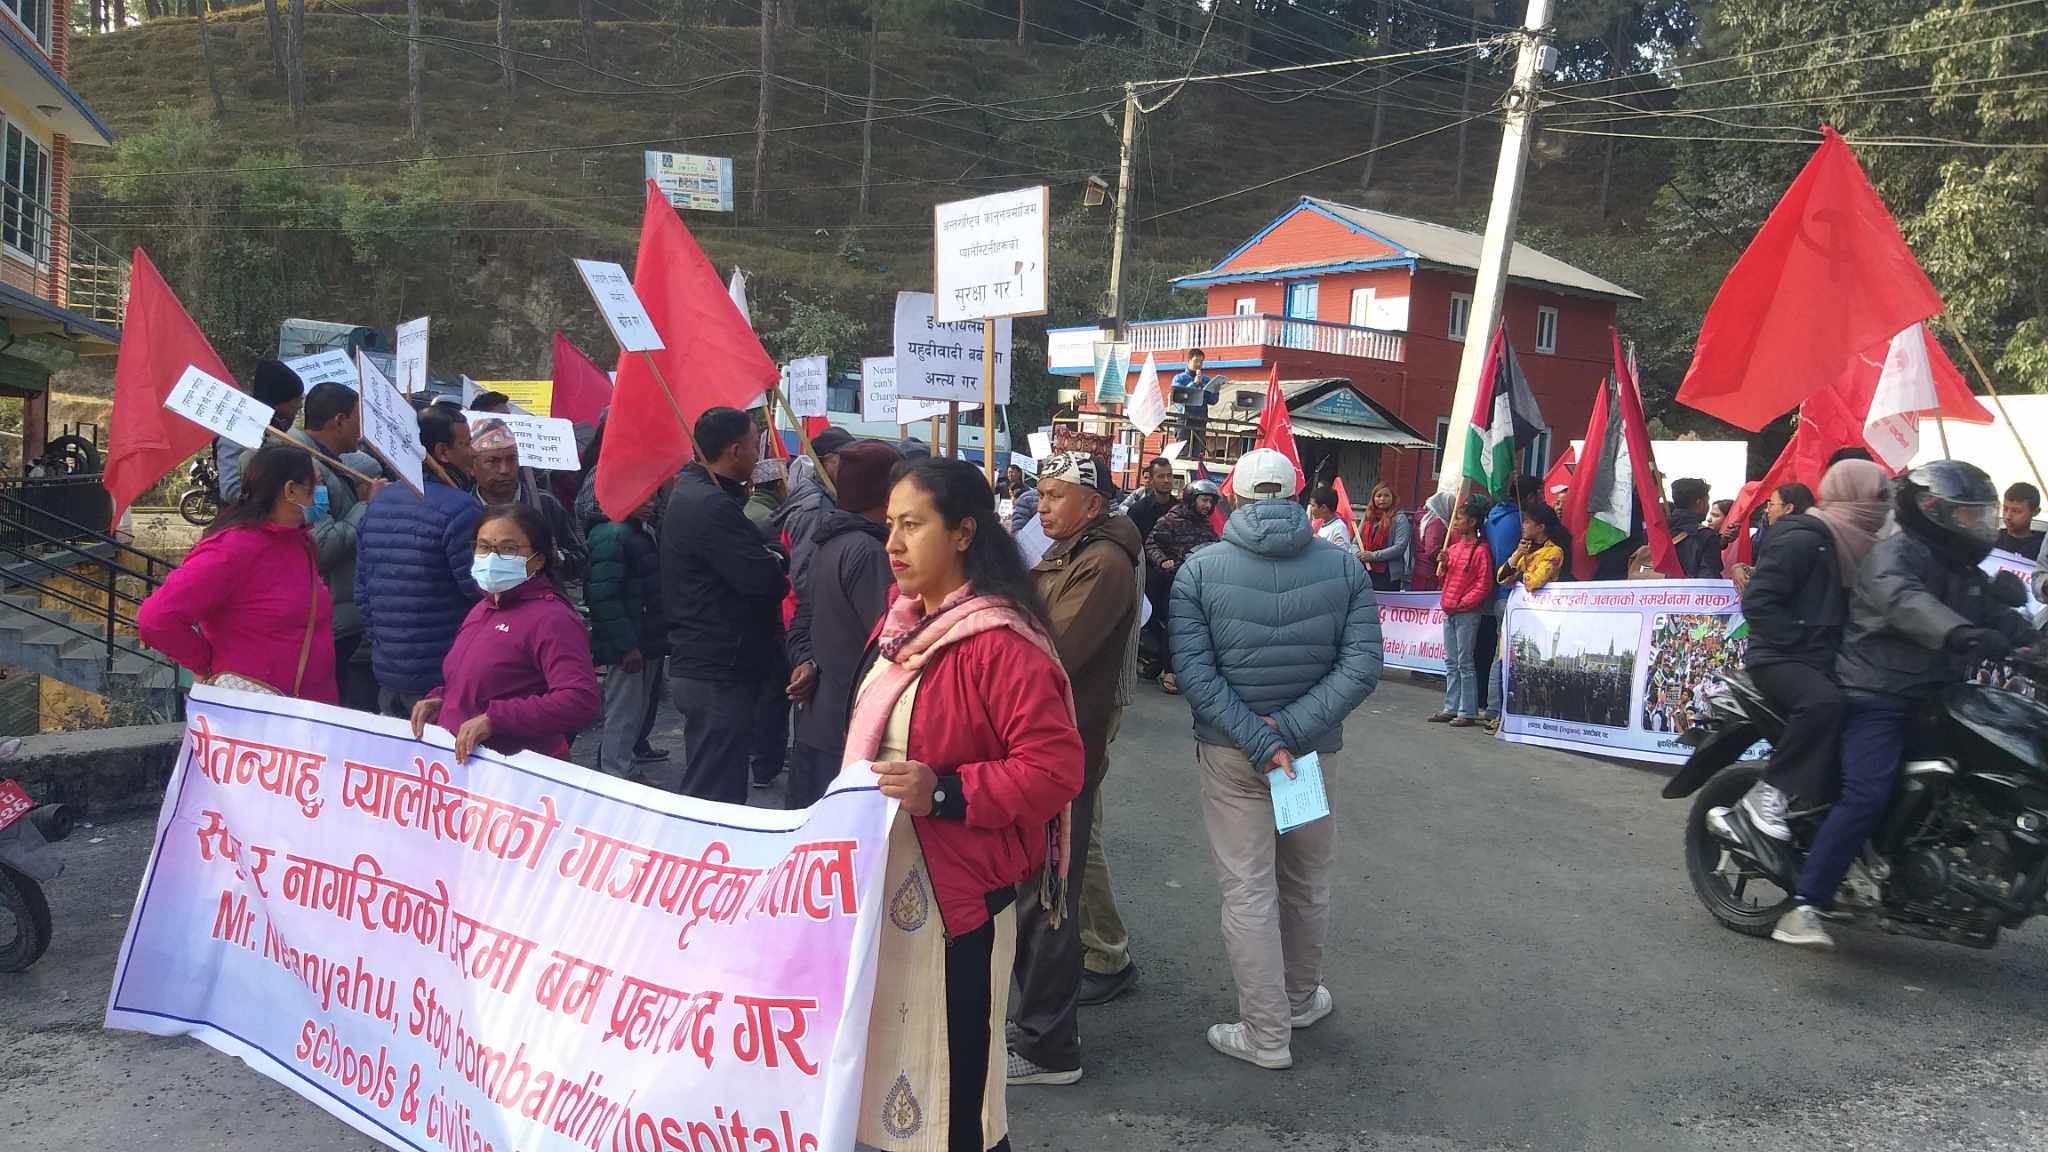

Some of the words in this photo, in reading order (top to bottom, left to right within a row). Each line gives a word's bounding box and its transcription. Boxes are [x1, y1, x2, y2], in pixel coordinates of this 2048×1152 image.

[954, 284, 987, 311] सुरक्षा
[993, 280, 1011, 300] गर
[925, 372, 956, 388] अन्त्य
[961, 375, 978, 391] गर
[1639, 592, 1692, 607] समर्थनमा
[212, 889, 256, 951] Mr.
[409, 976, 450, 1071] Stop
[283, 853, 450, 953] नागरिकको
[535, 950, 614, 1025] बम
[733, 994, 819, 1077] गर
[296, 1019, 396, 1110] schools
[400, 1063, 421, 1126] &
